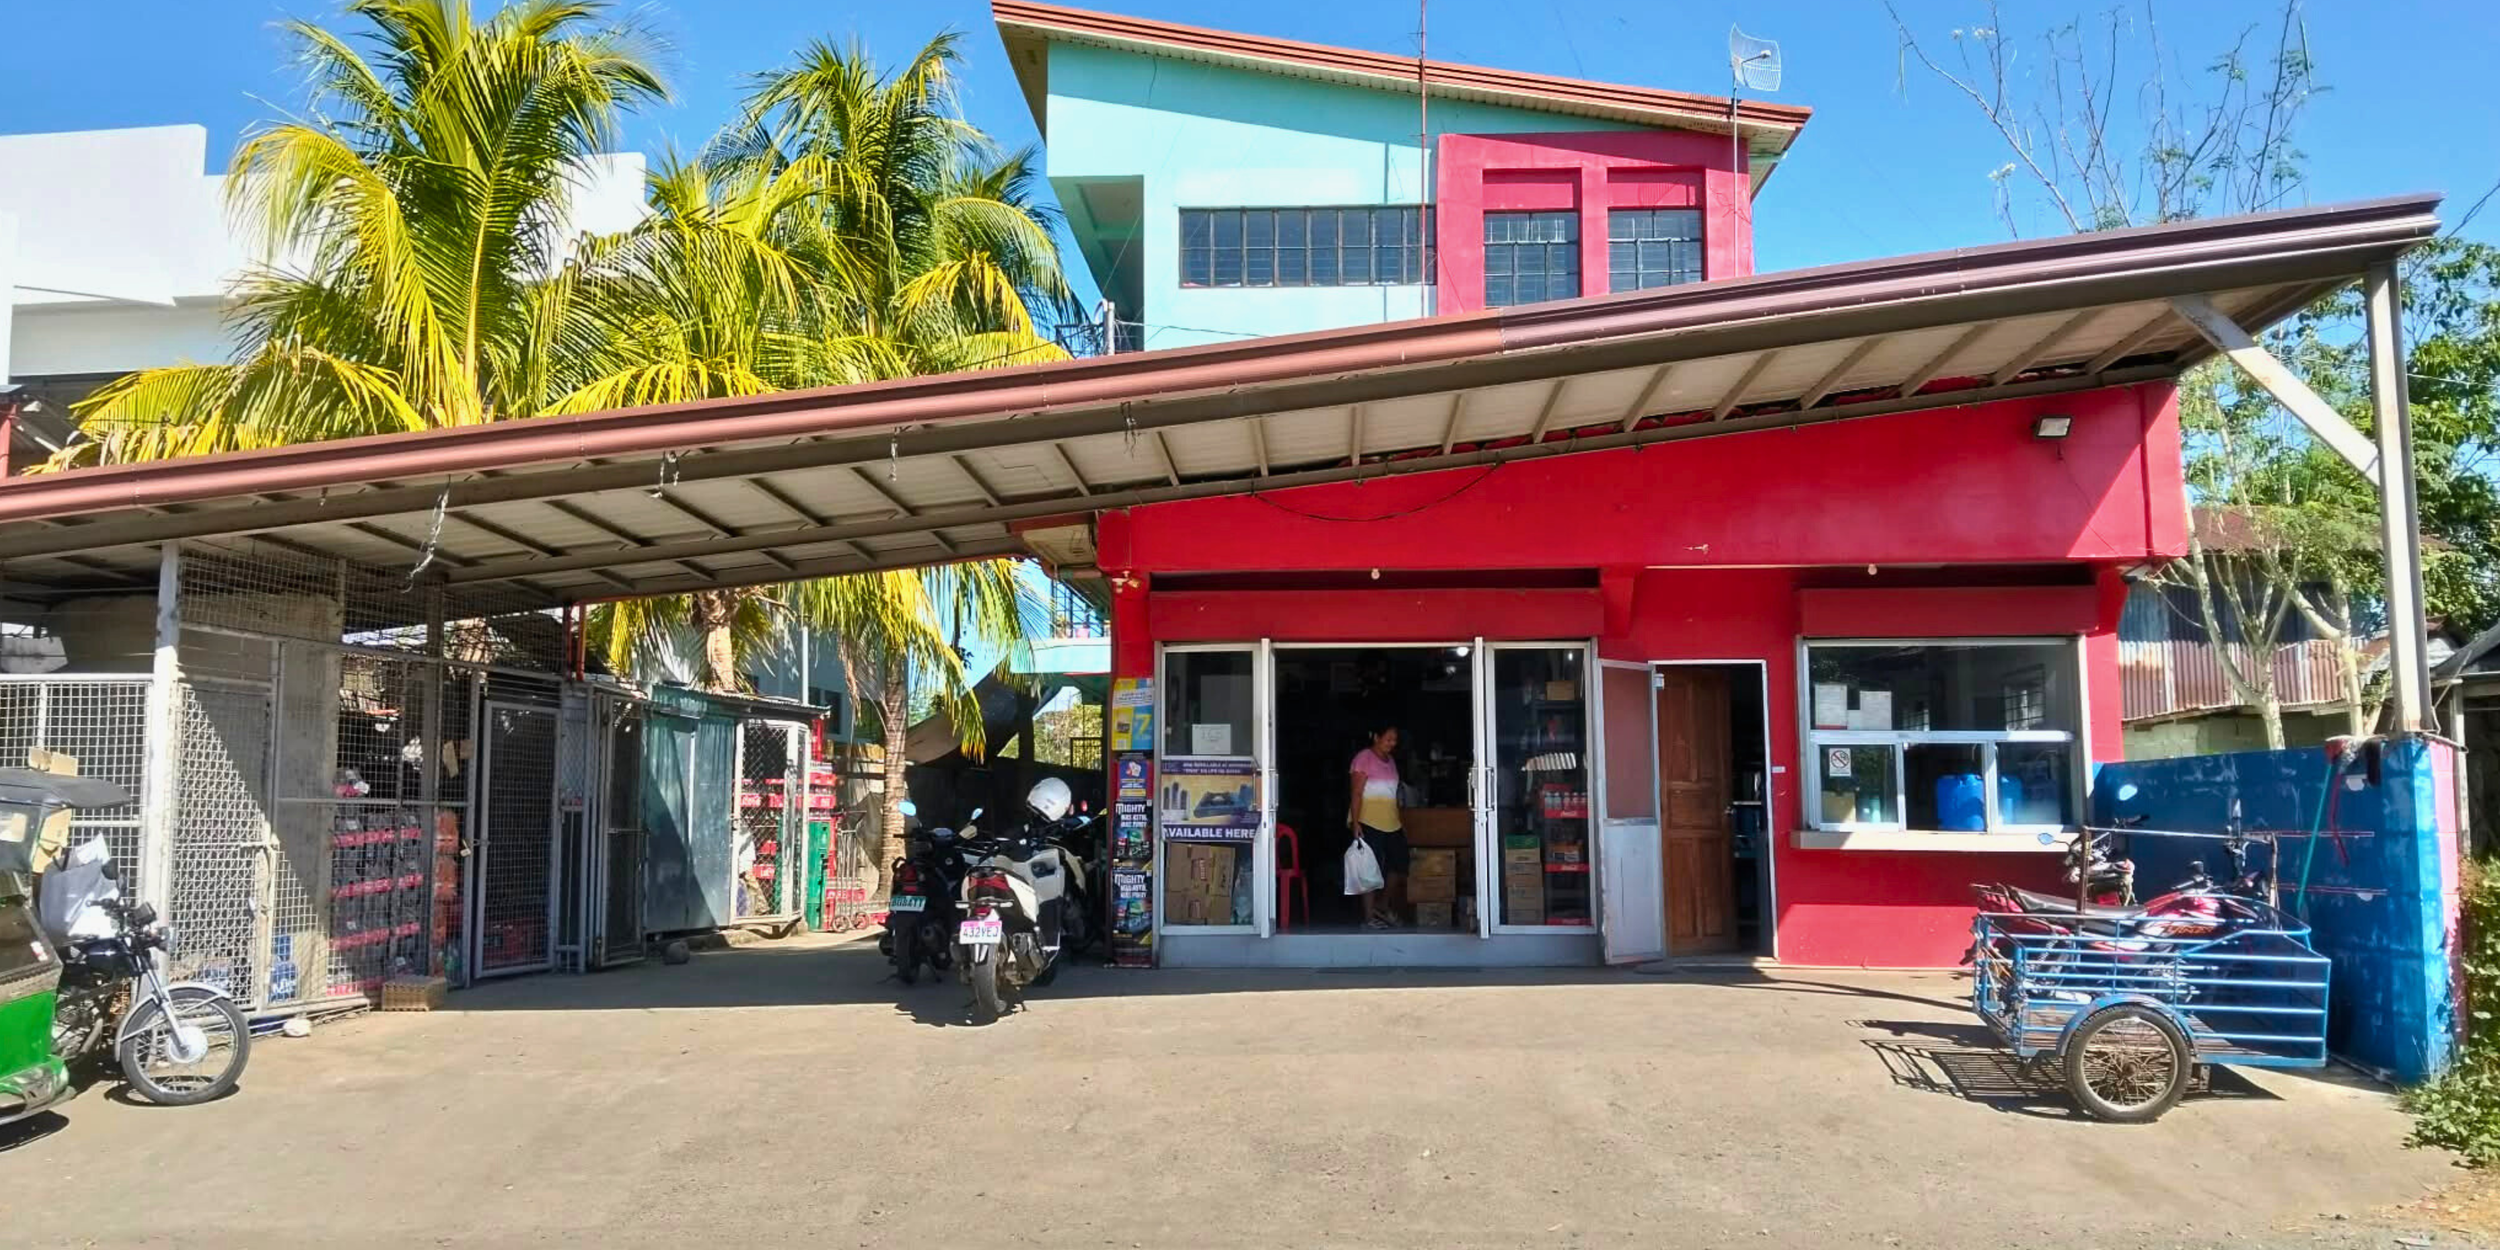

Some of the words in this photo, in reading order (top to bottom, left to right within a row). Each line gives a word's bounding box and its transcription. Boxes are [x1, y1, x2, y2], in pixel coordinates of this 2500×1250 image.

[1115, 803, 1146, 815] MIGHTY
[1225, 828, 1256, 840] HERE
[1114, 874, 1145, 886] MIGHTY
